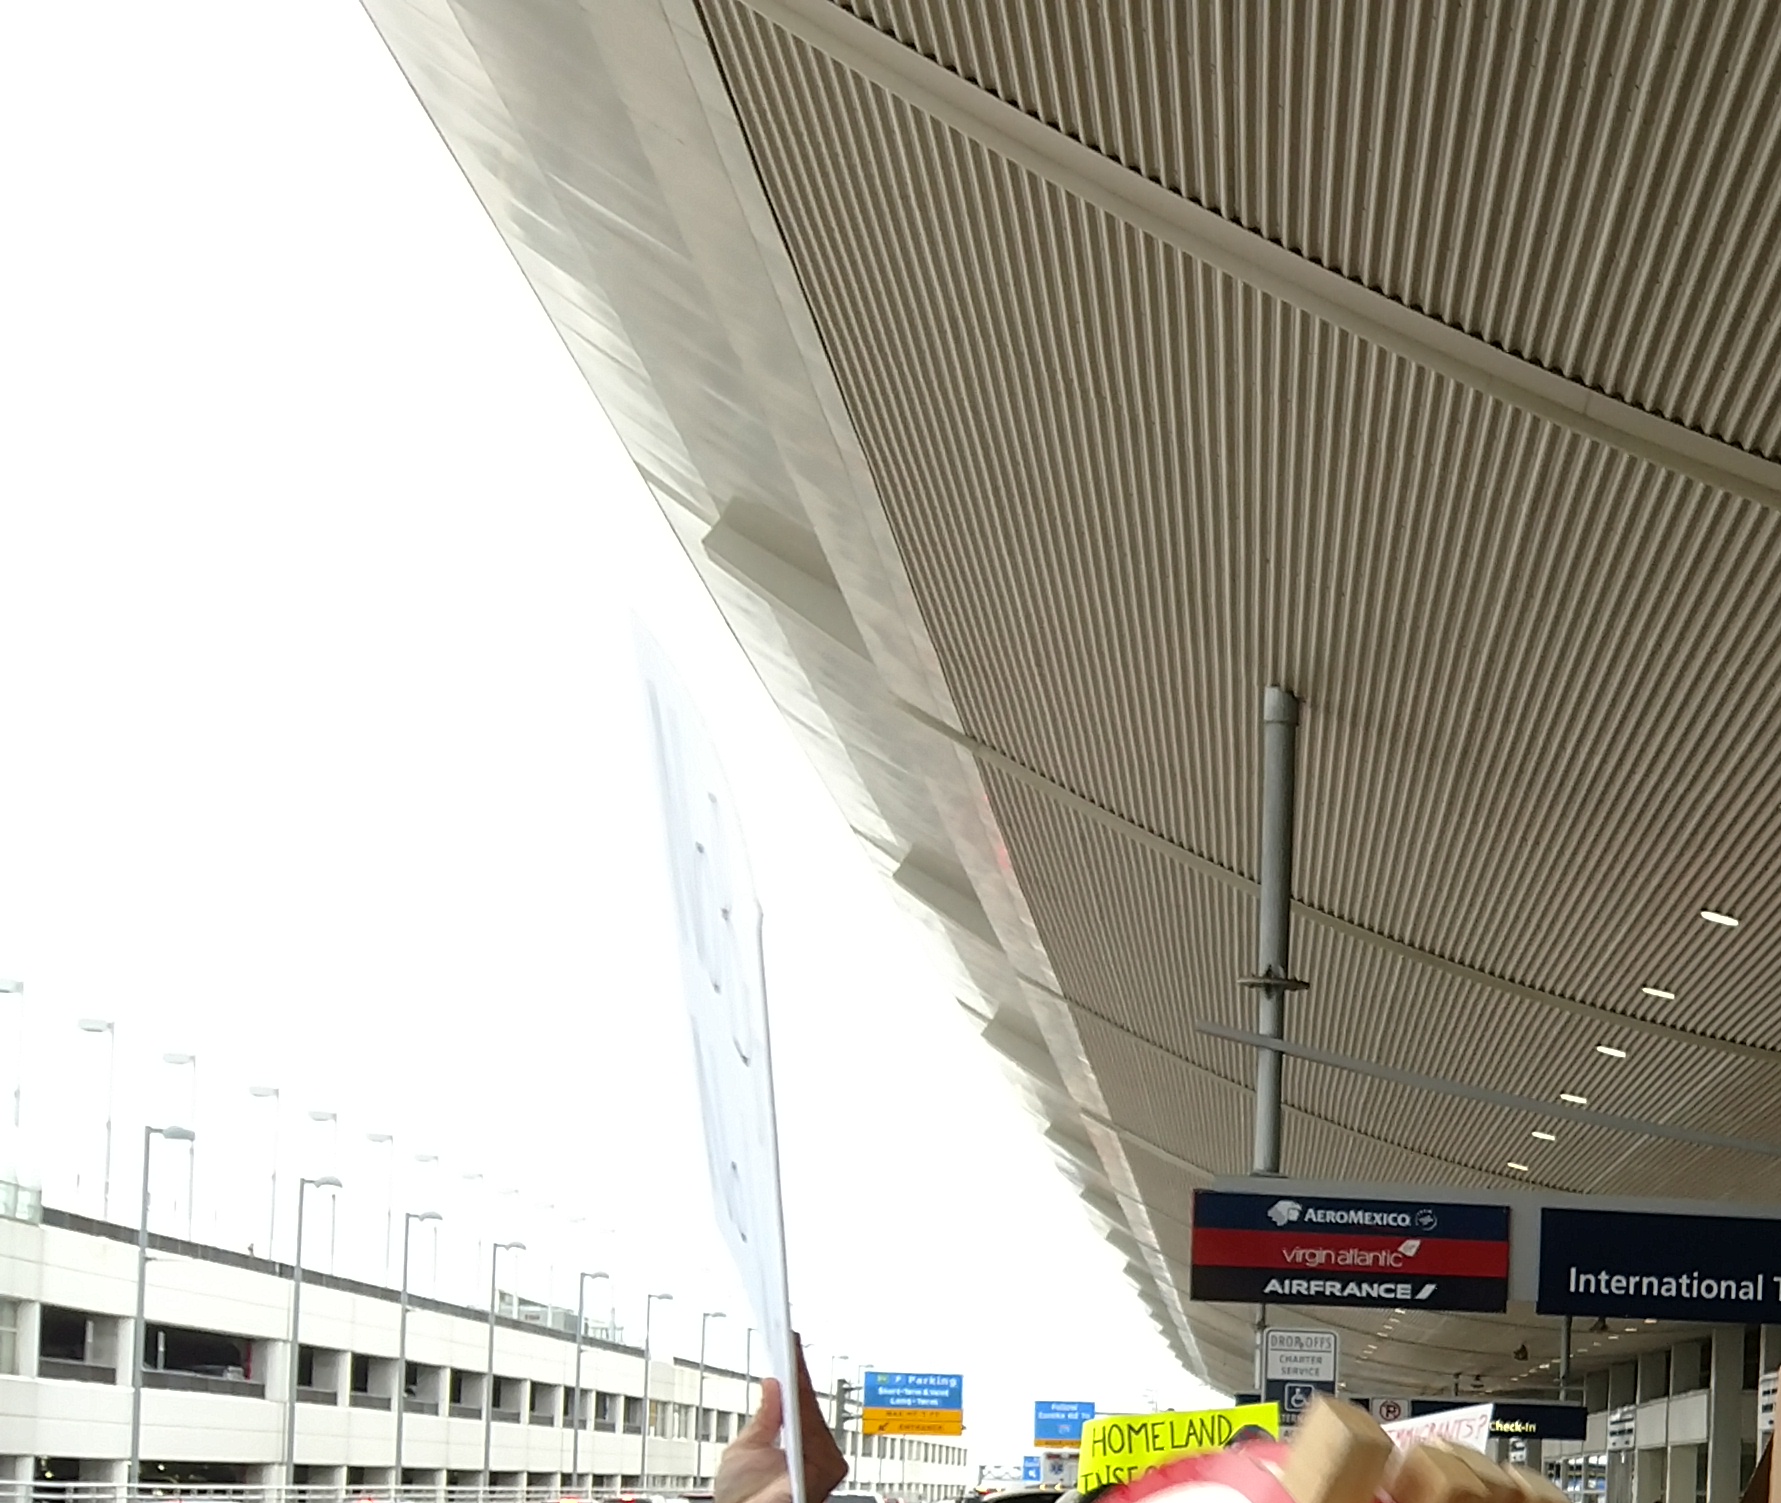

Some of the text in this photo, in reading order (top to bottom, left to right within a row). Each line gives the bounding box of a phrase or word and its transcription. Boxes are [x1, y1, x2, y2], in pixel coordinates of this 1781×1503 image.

[1282, 1247, 1403, 1268] virgin atlantic
[1569, 1266, 1763, 1301] International
[908, 1375, 957, 1388] Parking
[1281, 1366, 1320, 1377] SERVICE
[1092, 1414, 1233, 1458] HOMELAND
